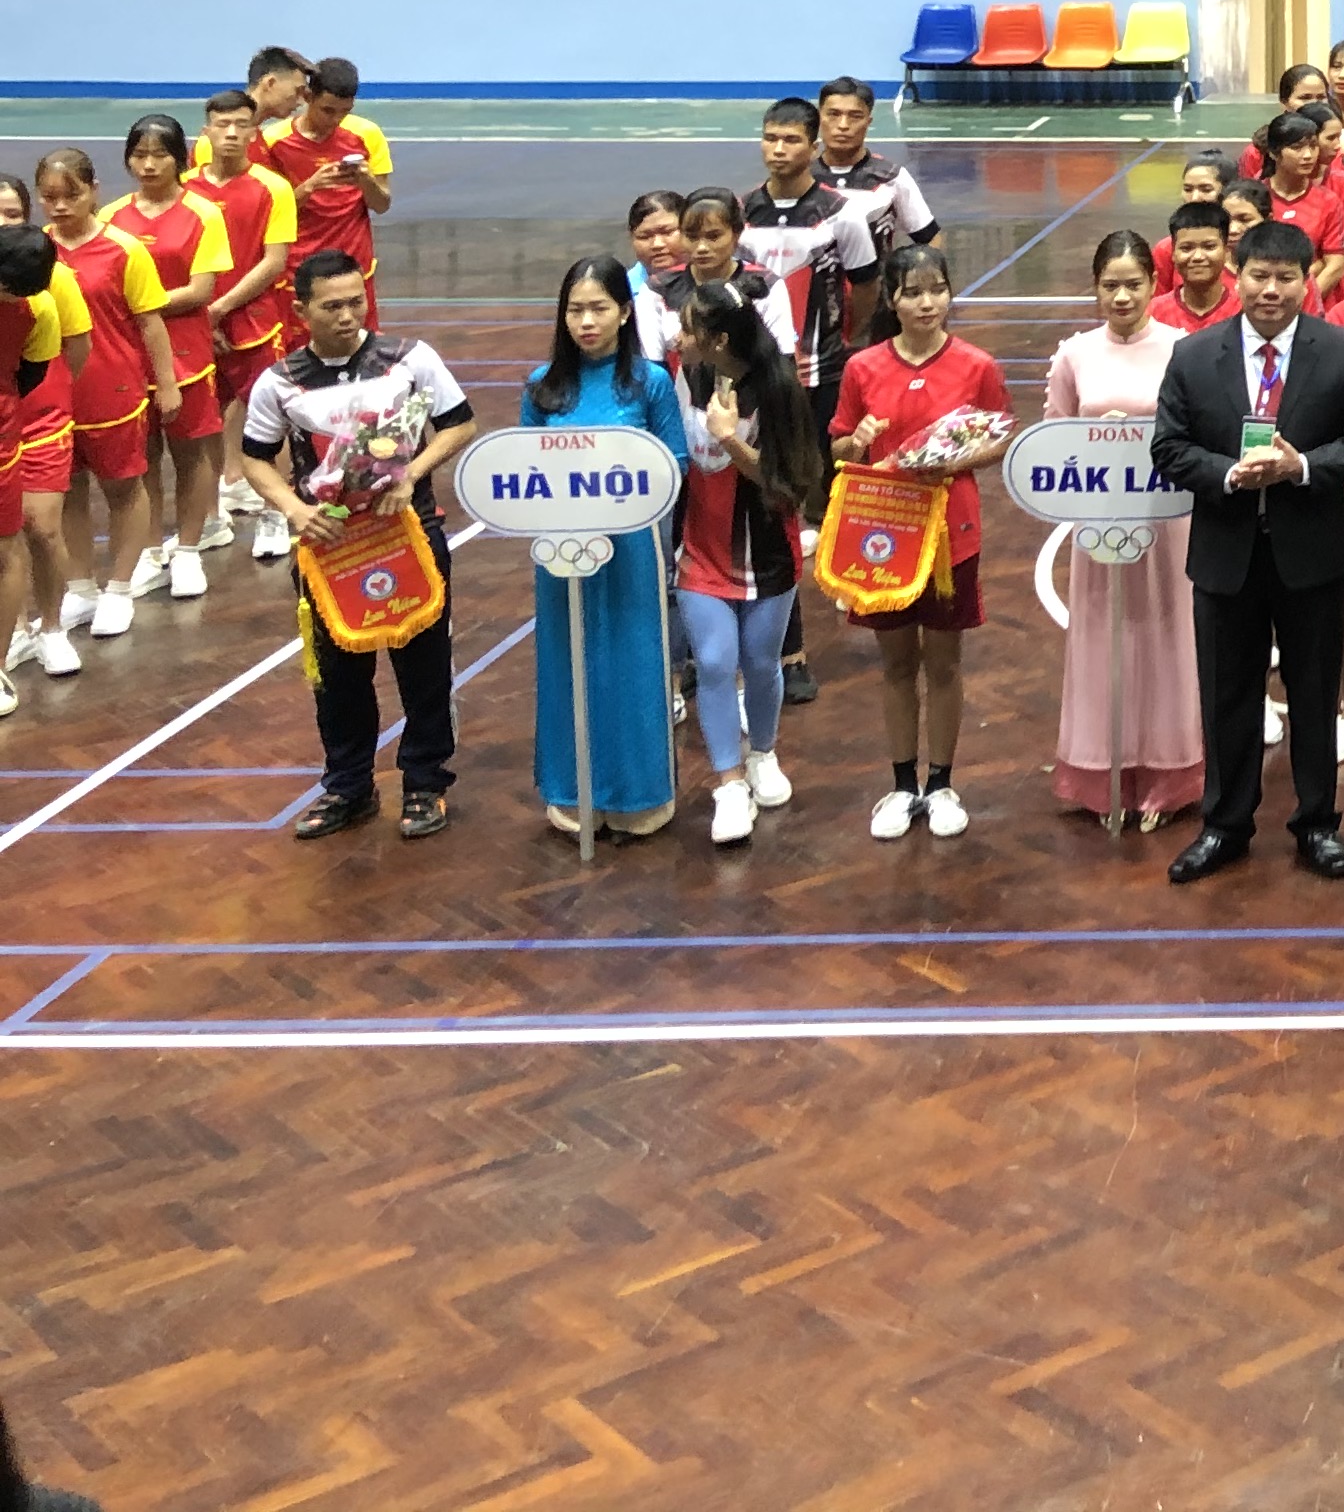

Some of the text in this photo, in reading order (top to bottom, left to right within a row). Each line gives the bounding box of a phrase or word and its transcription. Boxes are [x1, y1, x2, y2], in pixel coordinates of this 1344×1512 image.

[492, 463, 649, 503] HÀ NỘI
[1031, 455, 1110, 493] ĐẮK
